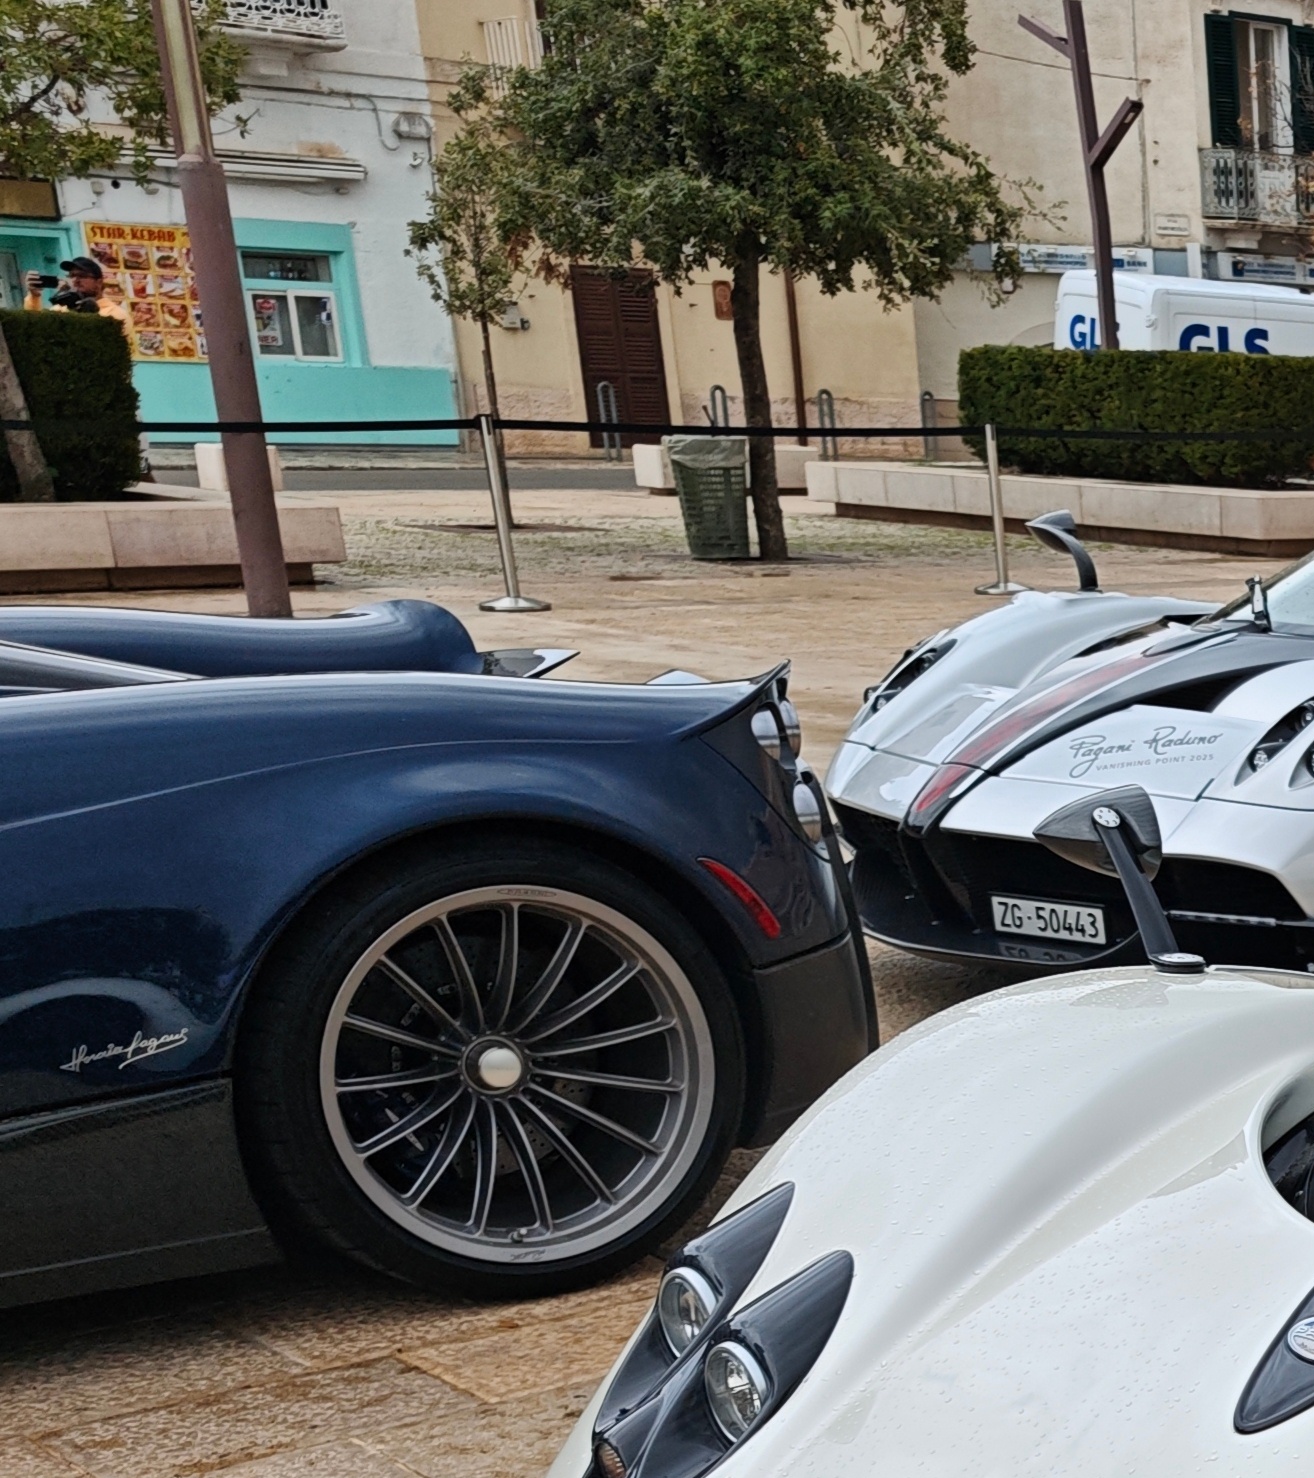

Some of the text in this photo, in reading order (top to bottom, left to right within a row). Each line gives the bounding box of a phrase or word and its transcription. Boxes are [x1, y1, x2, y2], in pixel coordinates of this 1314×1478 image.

[1069, 725, 1224, 779] Pagani Raduno
[1096, 753, 1215, 772] VANISHING POINT 2025
